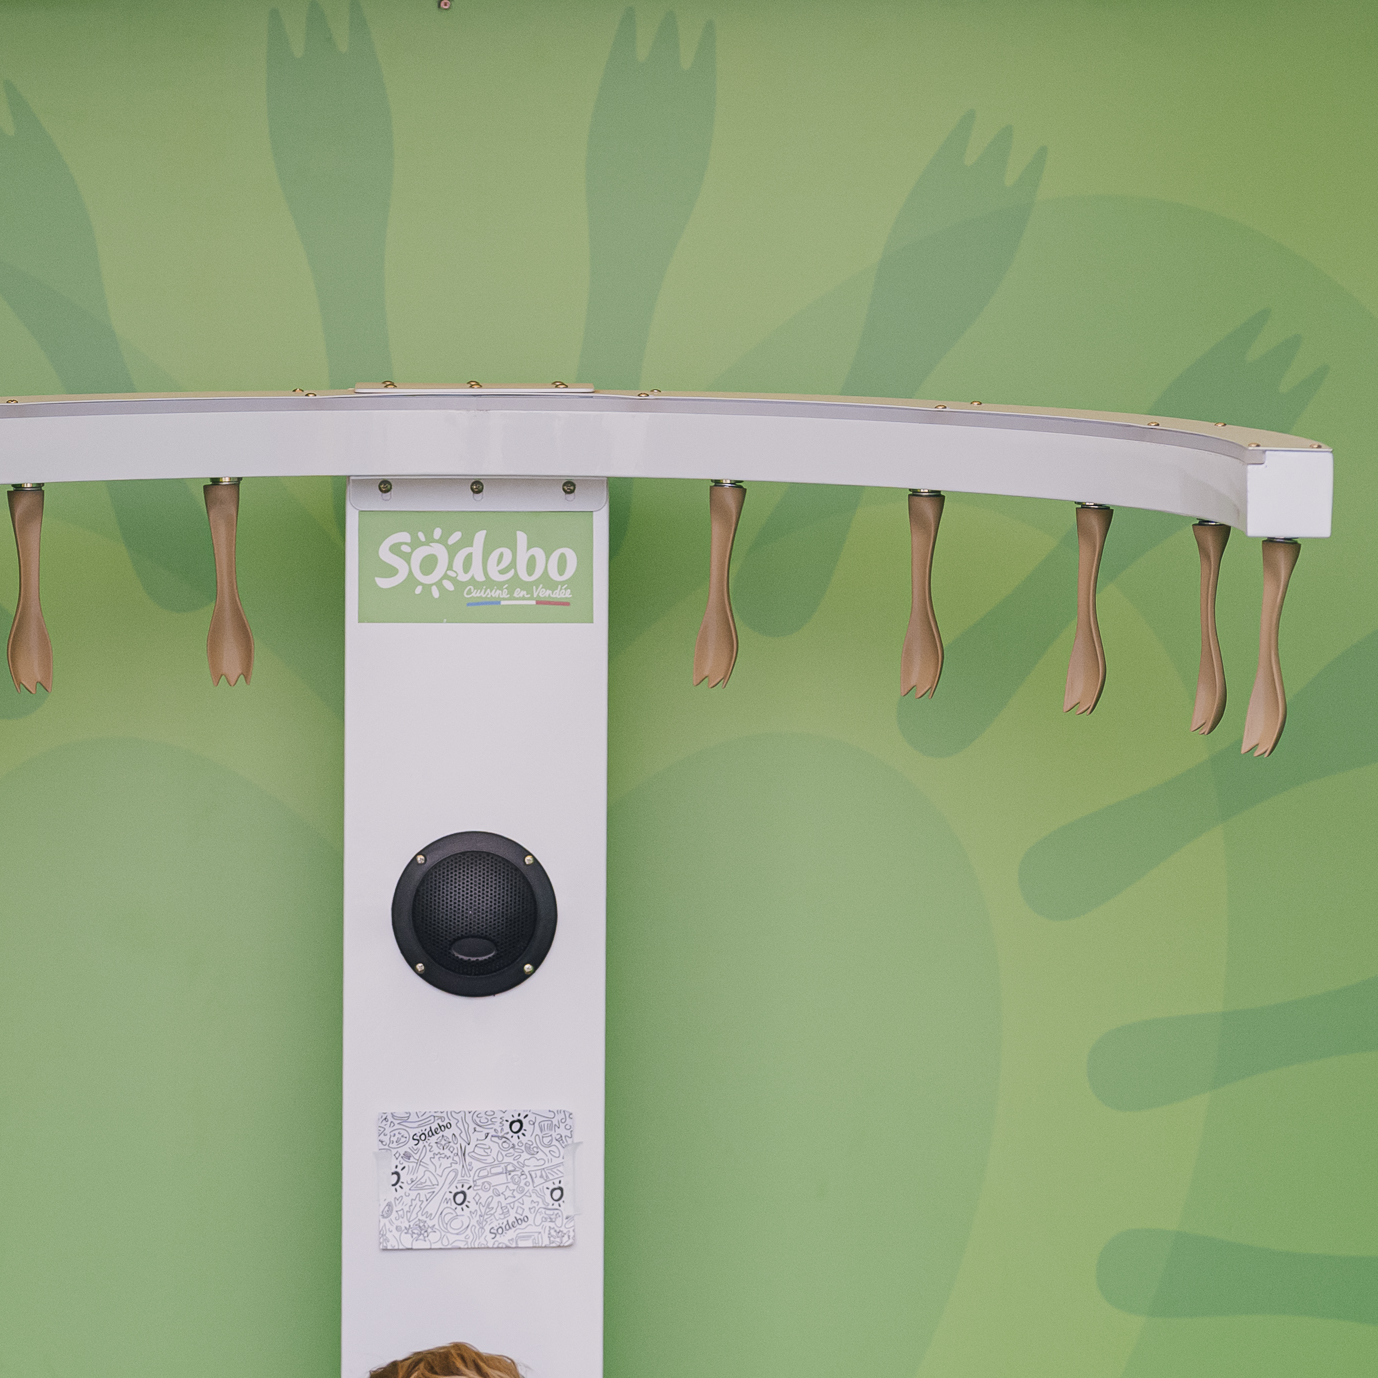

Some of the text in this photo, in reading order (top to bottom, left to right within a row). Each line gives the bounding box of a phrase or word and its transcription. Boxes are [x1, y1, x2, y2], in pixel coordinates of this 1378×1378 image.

[375, 528, 577, 597] Sodebo
[463, 584, 572, 598] Cuisiné en Vendée
[412, 1122, 452, 1146] Sodebo
[489, 1215, 529, 1240] Sodebo
